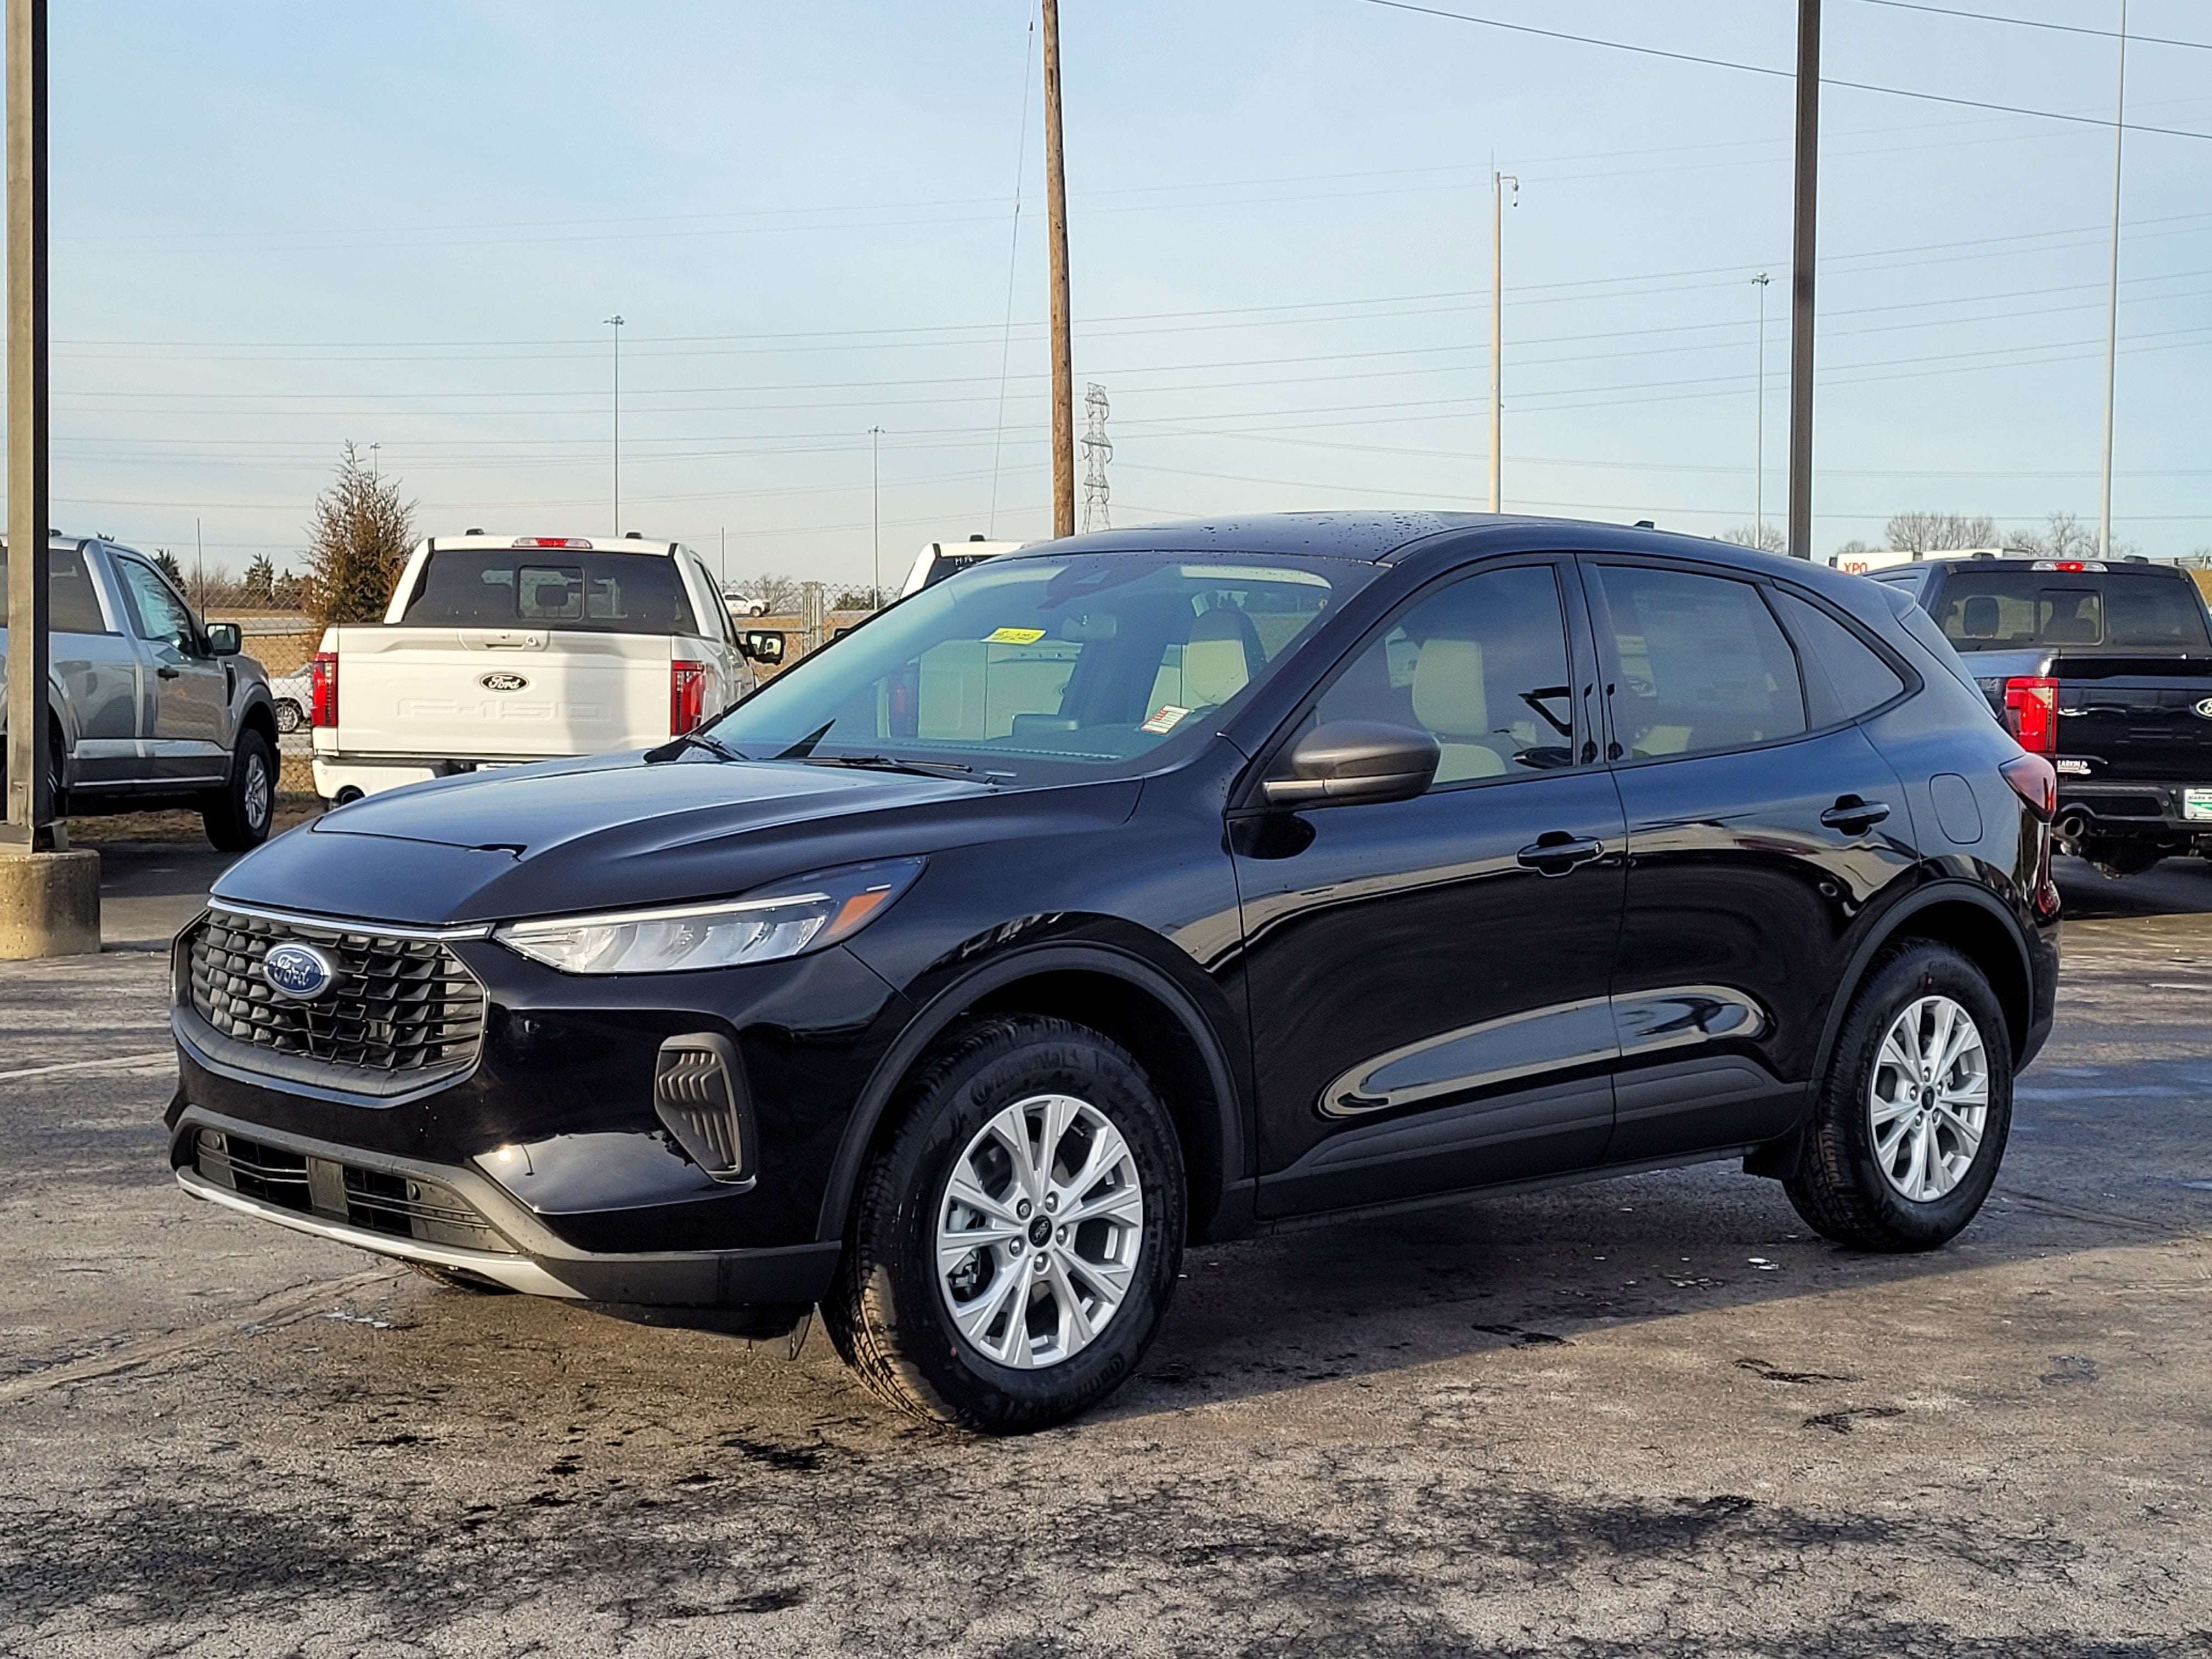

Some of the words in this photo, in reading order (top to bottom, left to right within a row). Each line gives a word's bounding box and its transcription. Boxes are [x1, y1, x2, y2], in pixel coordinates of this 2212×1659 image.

[1844, 562, 1868, 574] XPO
[488, 676, 520, 689] Ford
[398, 698, 611, 721] F-150
[269, 955, 310, 986] Ford
